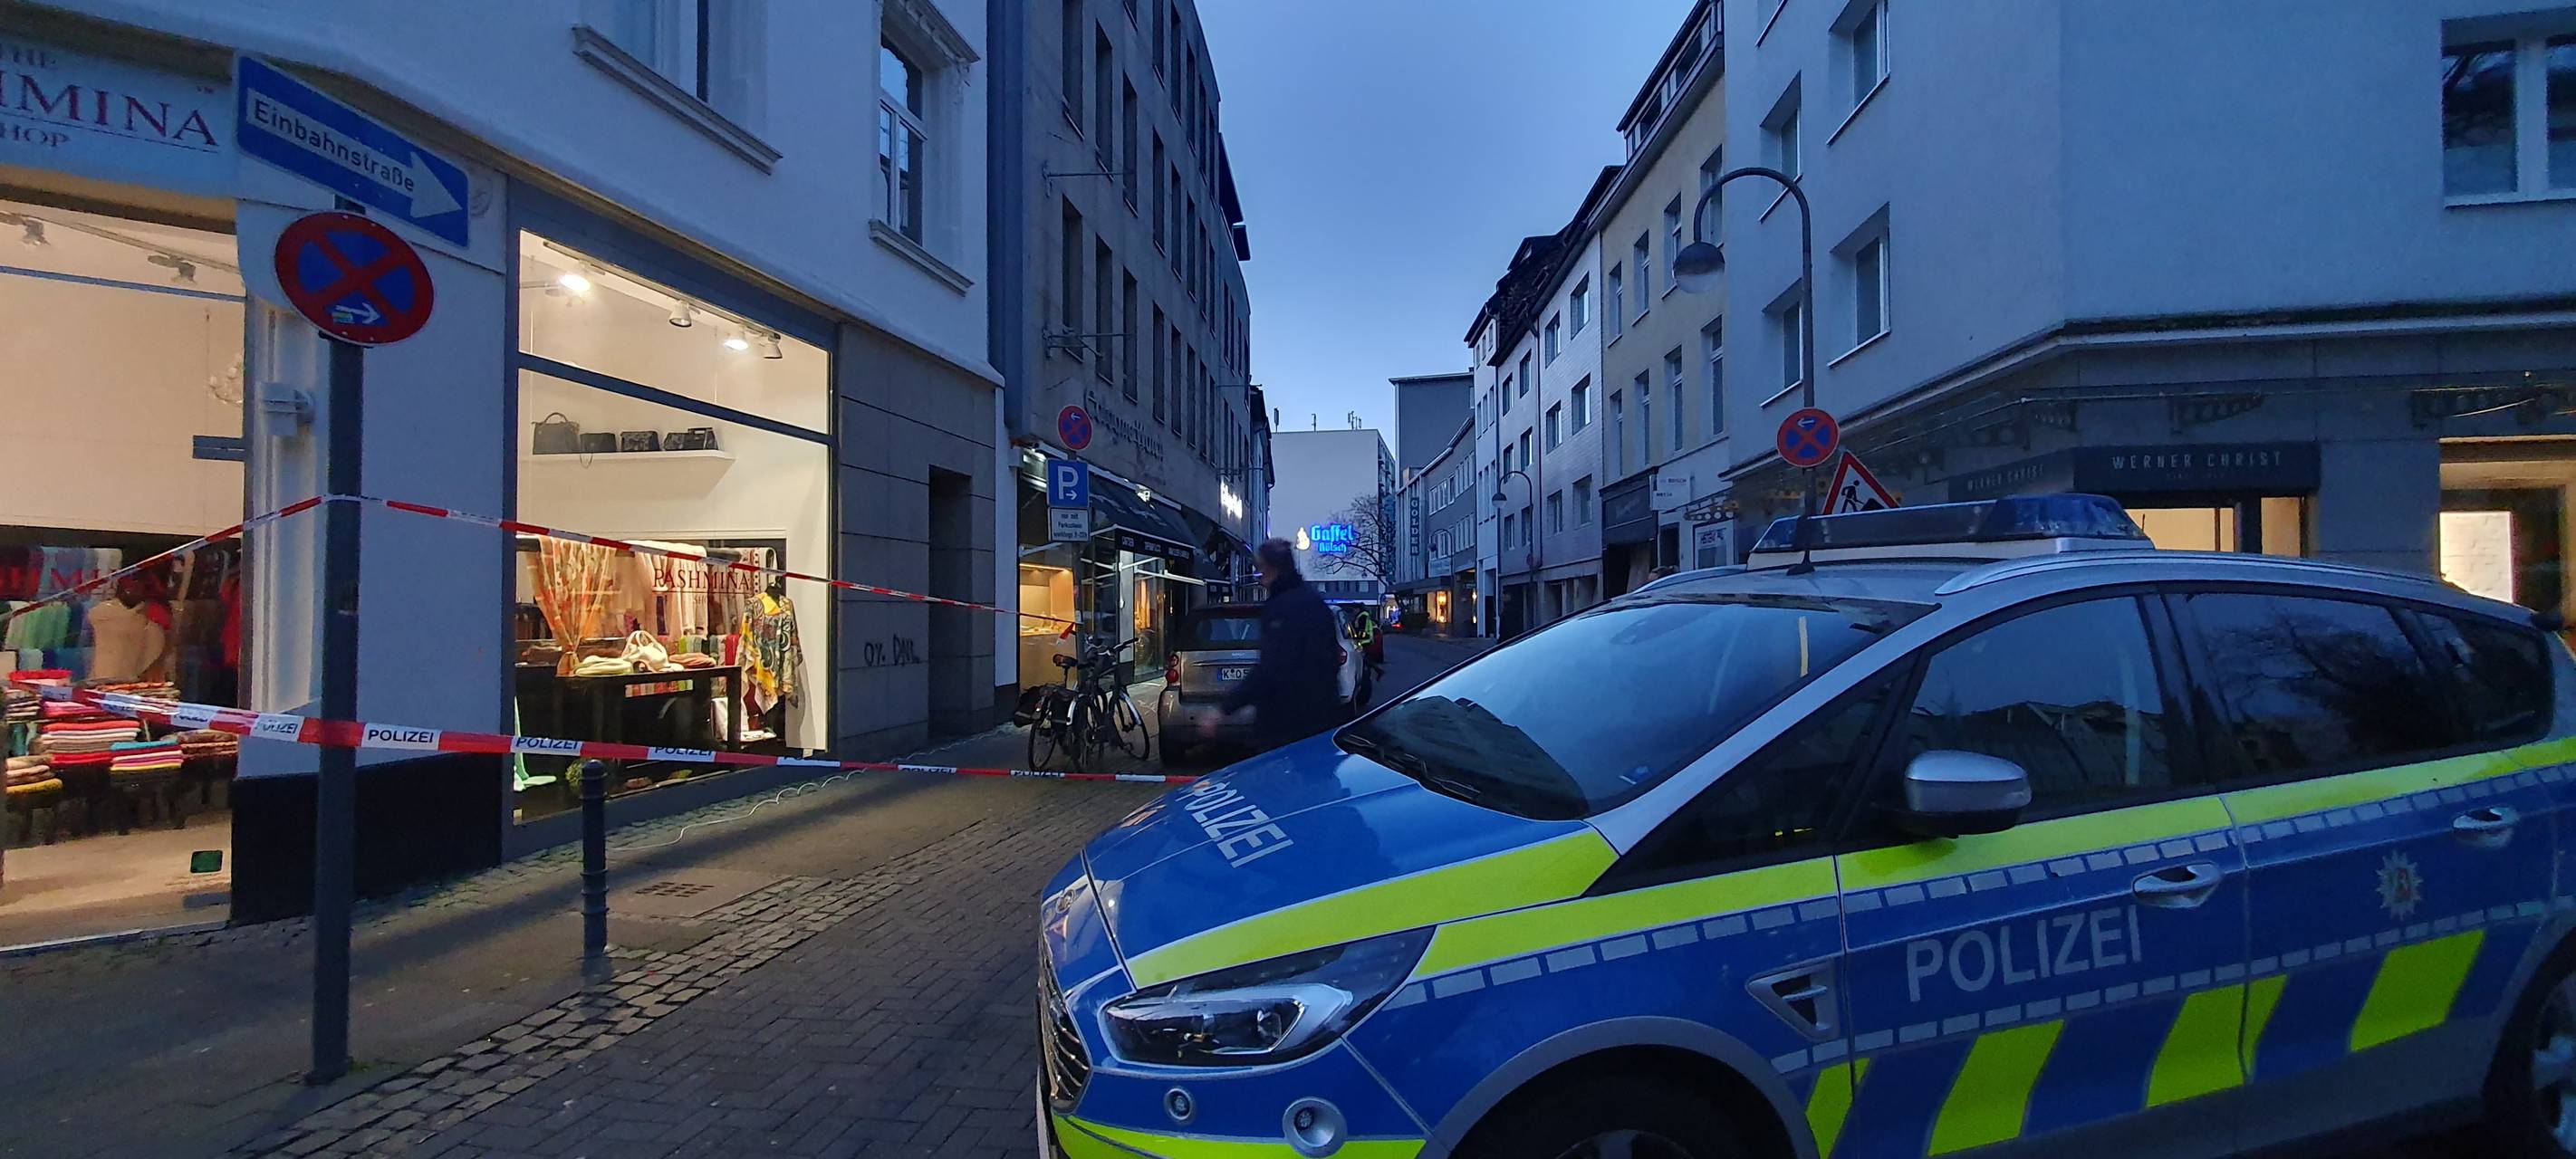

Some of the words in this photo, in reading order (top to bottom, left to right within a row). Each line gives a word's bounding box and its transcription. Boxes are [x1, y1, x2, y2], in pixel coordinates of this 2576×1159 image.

[0, 70, 219, 147] MINA
[254, 99, 415, 193] Einbahnstraße
[2112, 455, 2192, 469] WERNER
[2207, 452, 2282, 467] CHRIST
[1057, 465, 1079, 500] P
[1311, 524, 1354, 541] Gaffel
[653, 568, 750, 591] PASHMINA
[367, 728, 435, 744] POLIZEI
[514, 736, 580, 750] POLIZEI
[1176, 781, 1294, 869] POLIZEI
[1907, 905, 2142, 1002] POLIZEI
